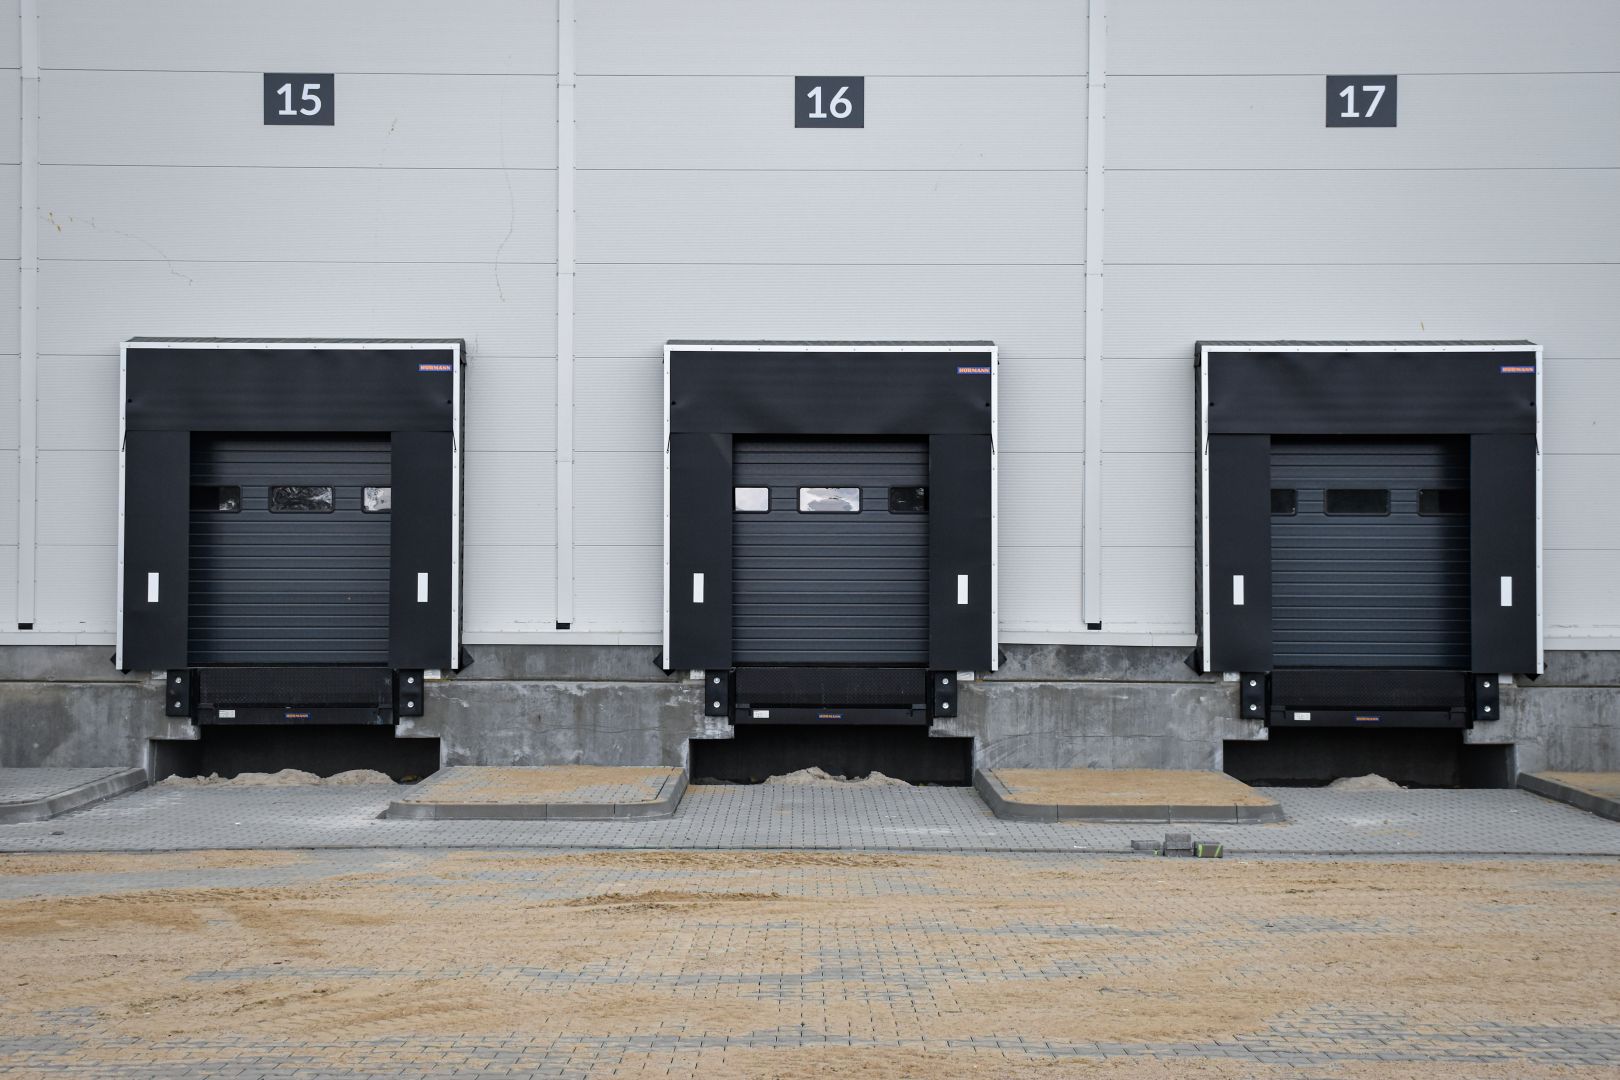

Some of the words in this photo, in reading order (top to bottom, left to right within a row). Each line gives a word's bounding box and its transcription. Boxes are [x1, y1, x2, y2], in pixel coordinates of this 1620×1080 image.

[277, 84, 321, 115] 15
[808, 87, 852, 118] 16
[1340, 86, 1385, 117] 17
